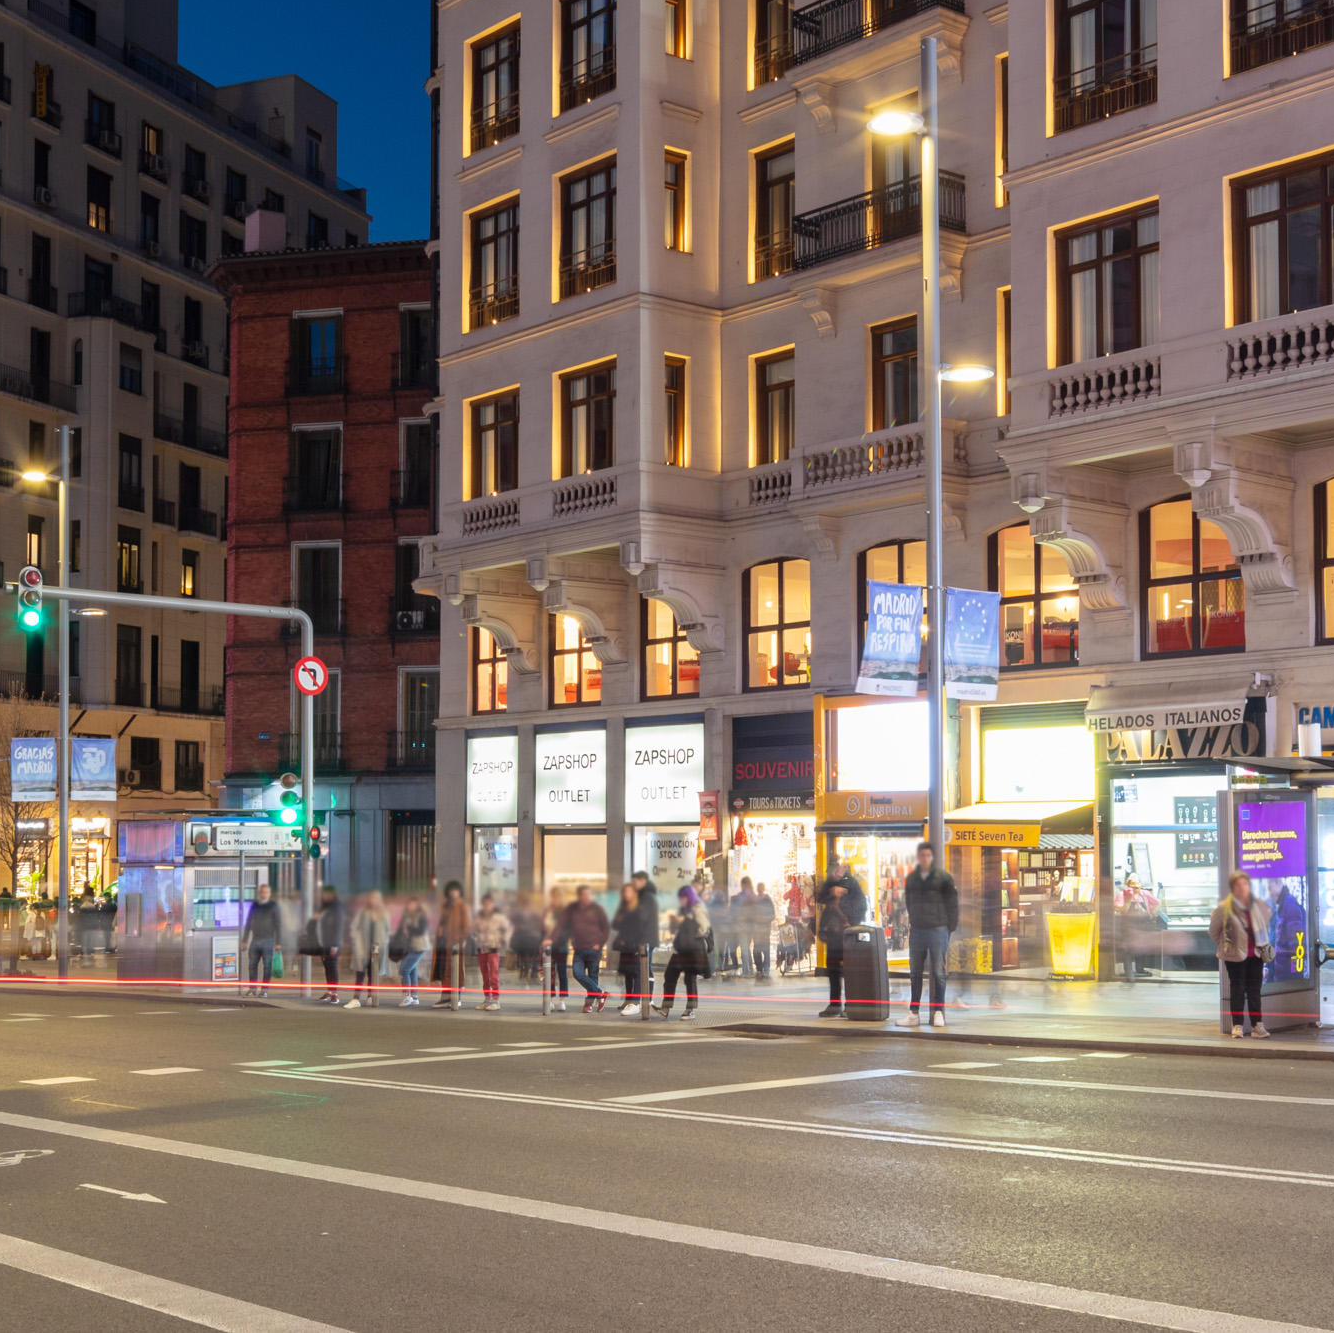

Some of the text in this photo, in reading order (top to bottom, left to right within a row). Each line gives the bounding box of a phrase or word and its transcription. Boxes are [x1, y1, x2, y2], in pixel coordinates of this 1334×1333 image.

[873, 591, 917, 615] MADRID
[876, 615, 911, 632] POR FIN
[870, 631, 916, 654] RESPIRA
[1089, 707, 1242, 731] HELADOS ITALIANOS
[1106, 721, 1260, 763] PALAZZO
[14, 746, 54, 761] GRACIAS
[634, 748, 695, 766] ZAPSHOP
[17, 761, 53, 775] MADRID
[472, 761, 514, 775] ZAPSHOP
[543, 753, 597, 771] ZAPSHOP
[549, 789, 590, 803] OUTLET
[640, 785, 688, 801] OUTLET
[220, 838, 268, 846] Los Mostenses
[979, 831, 1006, 842] Seven
[1008, 831, 1024, 842] Tea
[1242, 830, 1269, 840] Derechos
[659, 850, 683, 859] STOCK
[1295, 931, 1304, 973] YOU
